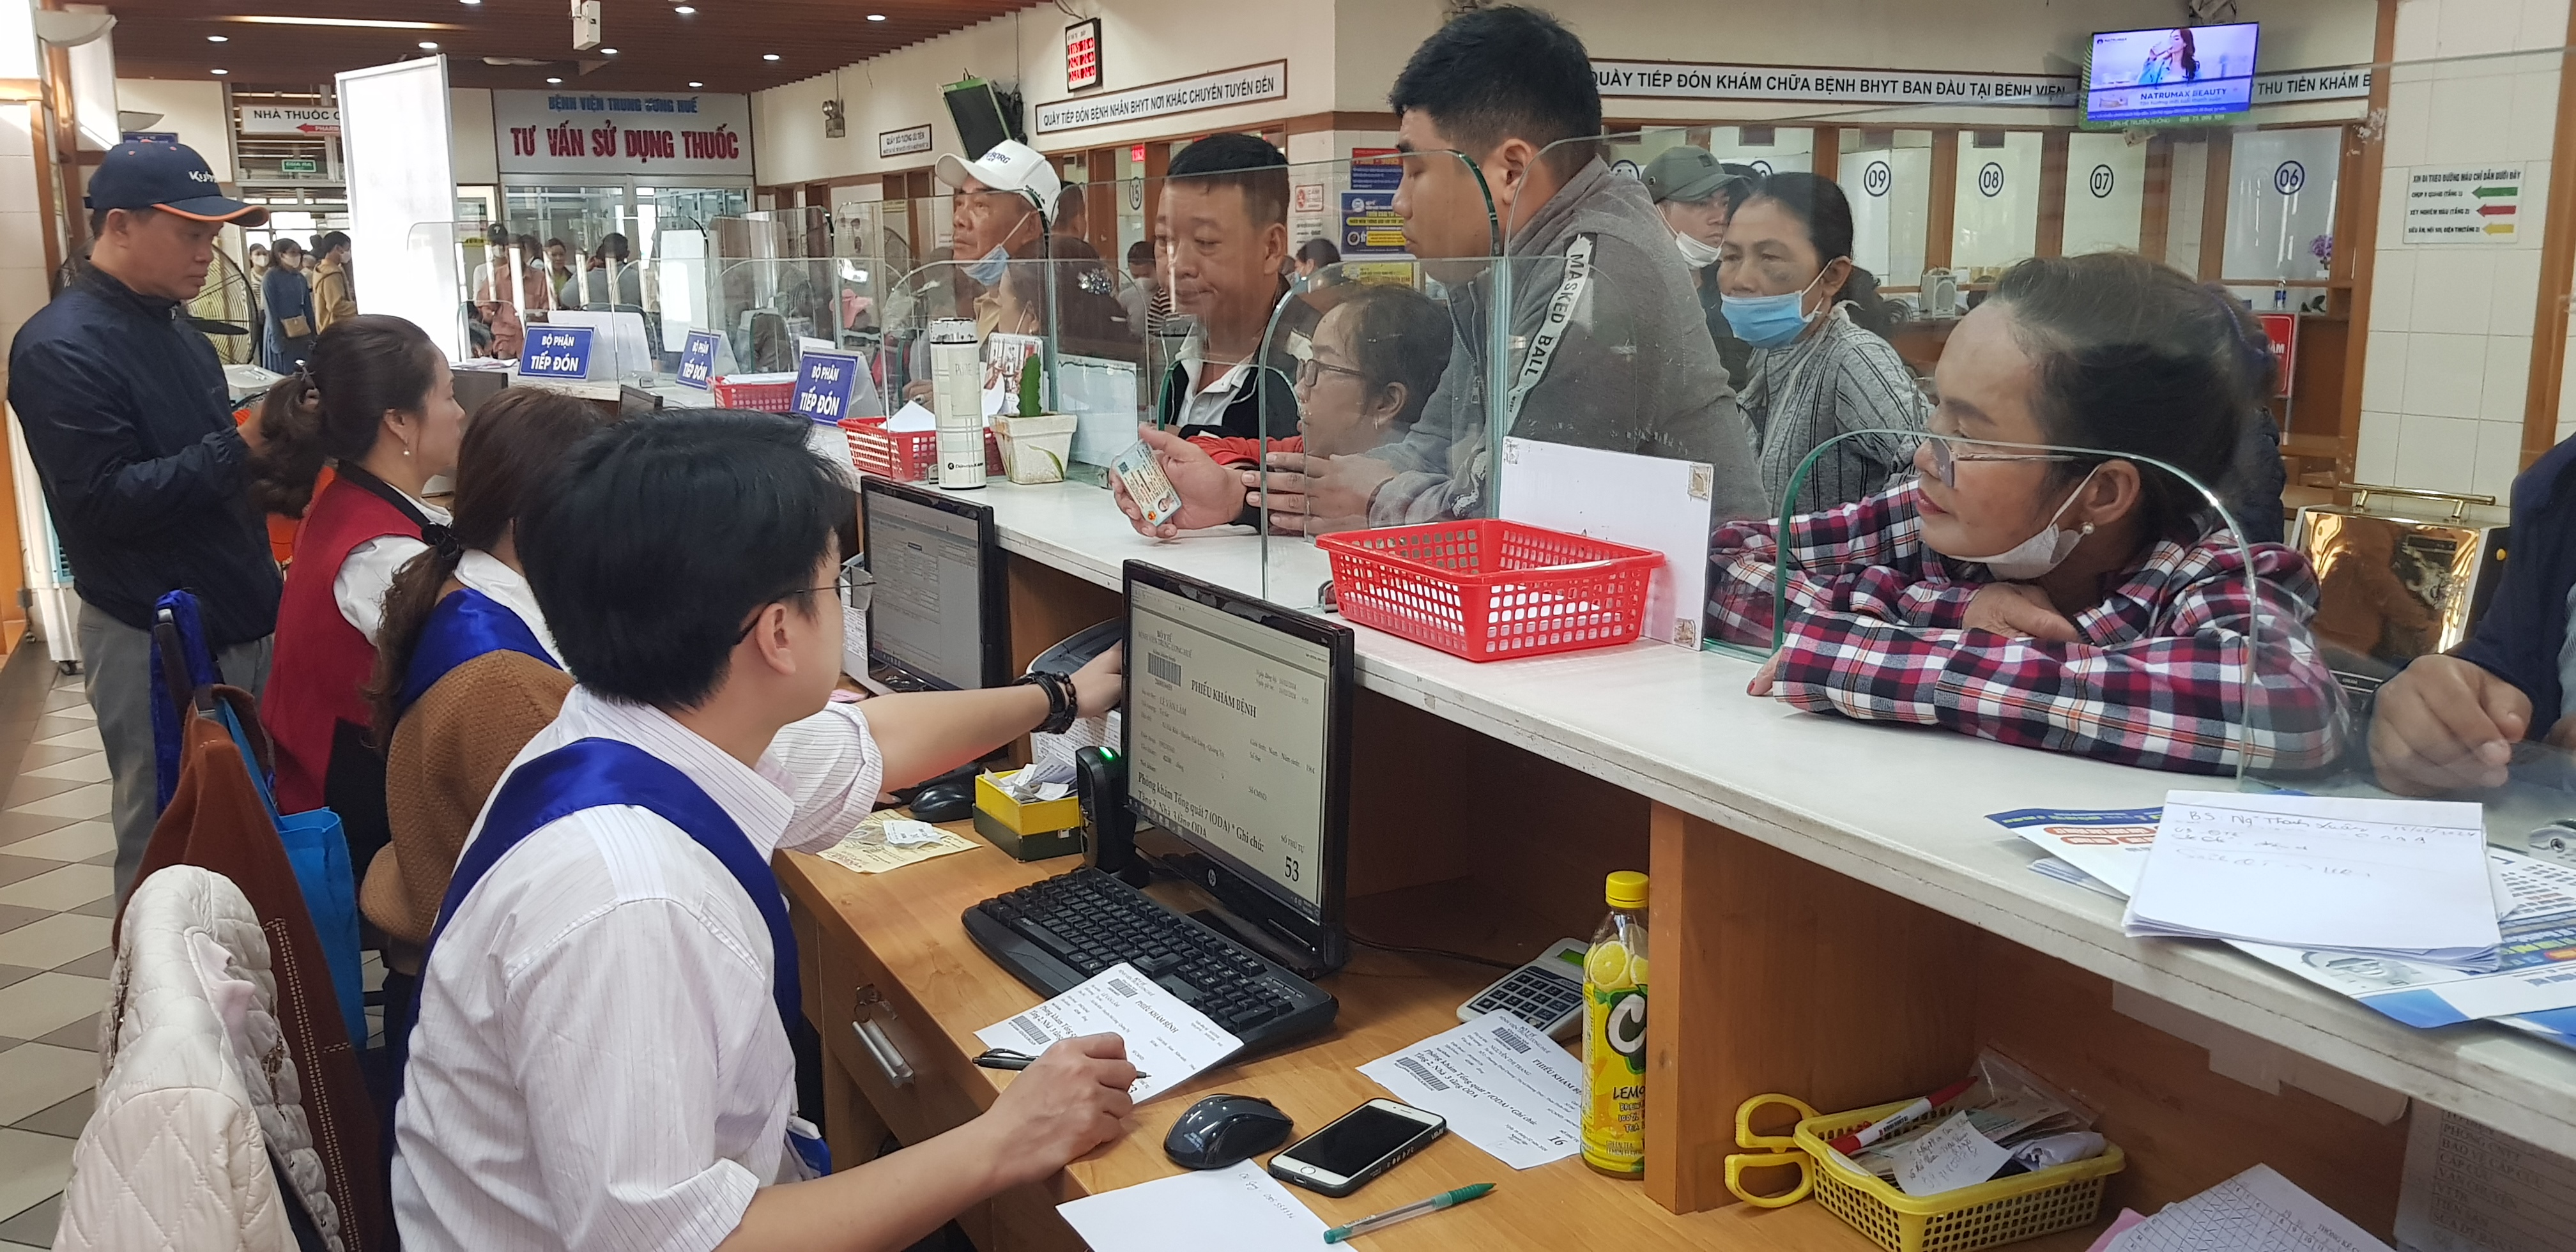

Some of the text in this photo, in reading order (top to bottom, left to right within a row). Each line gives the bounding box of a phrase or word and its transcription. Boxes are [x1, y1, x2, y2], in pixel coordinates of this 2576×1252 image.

[1637, 70, 1673, 88] TIẾP
[1677, 70, 1711, 89] ĐÓN
[1717, 72, 1761, 90] KHÁM
[1767, 73, 1811, 91] CHỮA
[1815, 75, 1855, 95] BỆNH
[1860, 79, 1899, 94] BHYT
[1903, 80, 1933, 95] BAN
[1936, 79, 1966, 96] ĐẦU
[1970, 82, 1991, 100] TẠI
[2258, 72, 2359, 95] THU TIỀN KHÁM
[548, 93, 576, 113] BỆNH
[579, 94, 604, 113] VIỆN
[608, 98, 642, 112] TRUNG
[1043, 75, 1275, 127] QUẦY TIẾP ĐÓN BỆNH NHÂN BHYT NƠI KHÁC CHUYỂN TUYẾN ĐẾN
[2141, 88, 2227, 100] NATRUMAX BEAUTY
[254, 109, 281, 119] NHÀ
[284, 109, 330, 120] THUỐC
[510, 119, 739, 164] TƯ VẤN SỬ DỤNG THUỐC
[1869, 171, 1887, 188] 09
[1984, 172, 2000, 189] 08
[2094, 172, 2110, 189] 07
[2280, 169, 2300, 187] 06
[1131, 184, 1140, 202] 15
[1525, 254, 1584, 377] MASKED BALL
[541, 335, 574, 348] BỘ PHẬN
[692, 339, 700, 353] BỘ
[530, 351, 579, 372] TIẾP ĐÓN
[684, 359, 708, 381] TIẾP ĐÓN
[811, 363, 839, 382] BỘ PHẬN
[801, 388, 840, 416] TIẾP ĐÓN
[1192, 680, 1257, 718] PHIẾU KHÁM BỆNH
[1138, 772, 1156, 794] Phòng
[1156, 782, 1172, 800] khám
[1174, 791, 1189, 813] Tổng
[1190, 804, 1204, 818] quát
[1204, 809, 1209, 819] 7
[1209, 811, 1230, 834] (ODA)
[1236, 827, 1248, 844] Ghi
[1250, 836, 1264, 853] chú:
[1284, 855, 1299, 882] 53
[1423, 1049, 1442, 1065] Phòng
[1440, 1060, 1458, 1074] khám
[1457, 1071, 1472, 1085] Tổng
[1532, 1058, 1575, 1090] PHIẾU KHÁM
[1461, 1087, 1479, 1099] ODA
[1613, 1085, 1646, 1099] LEMO
[1618, 1113, 1639, 1122] 100%
[1623, 1124, 1639, 1133] TEA
[1547, 1135, 1568, 1146] 16
